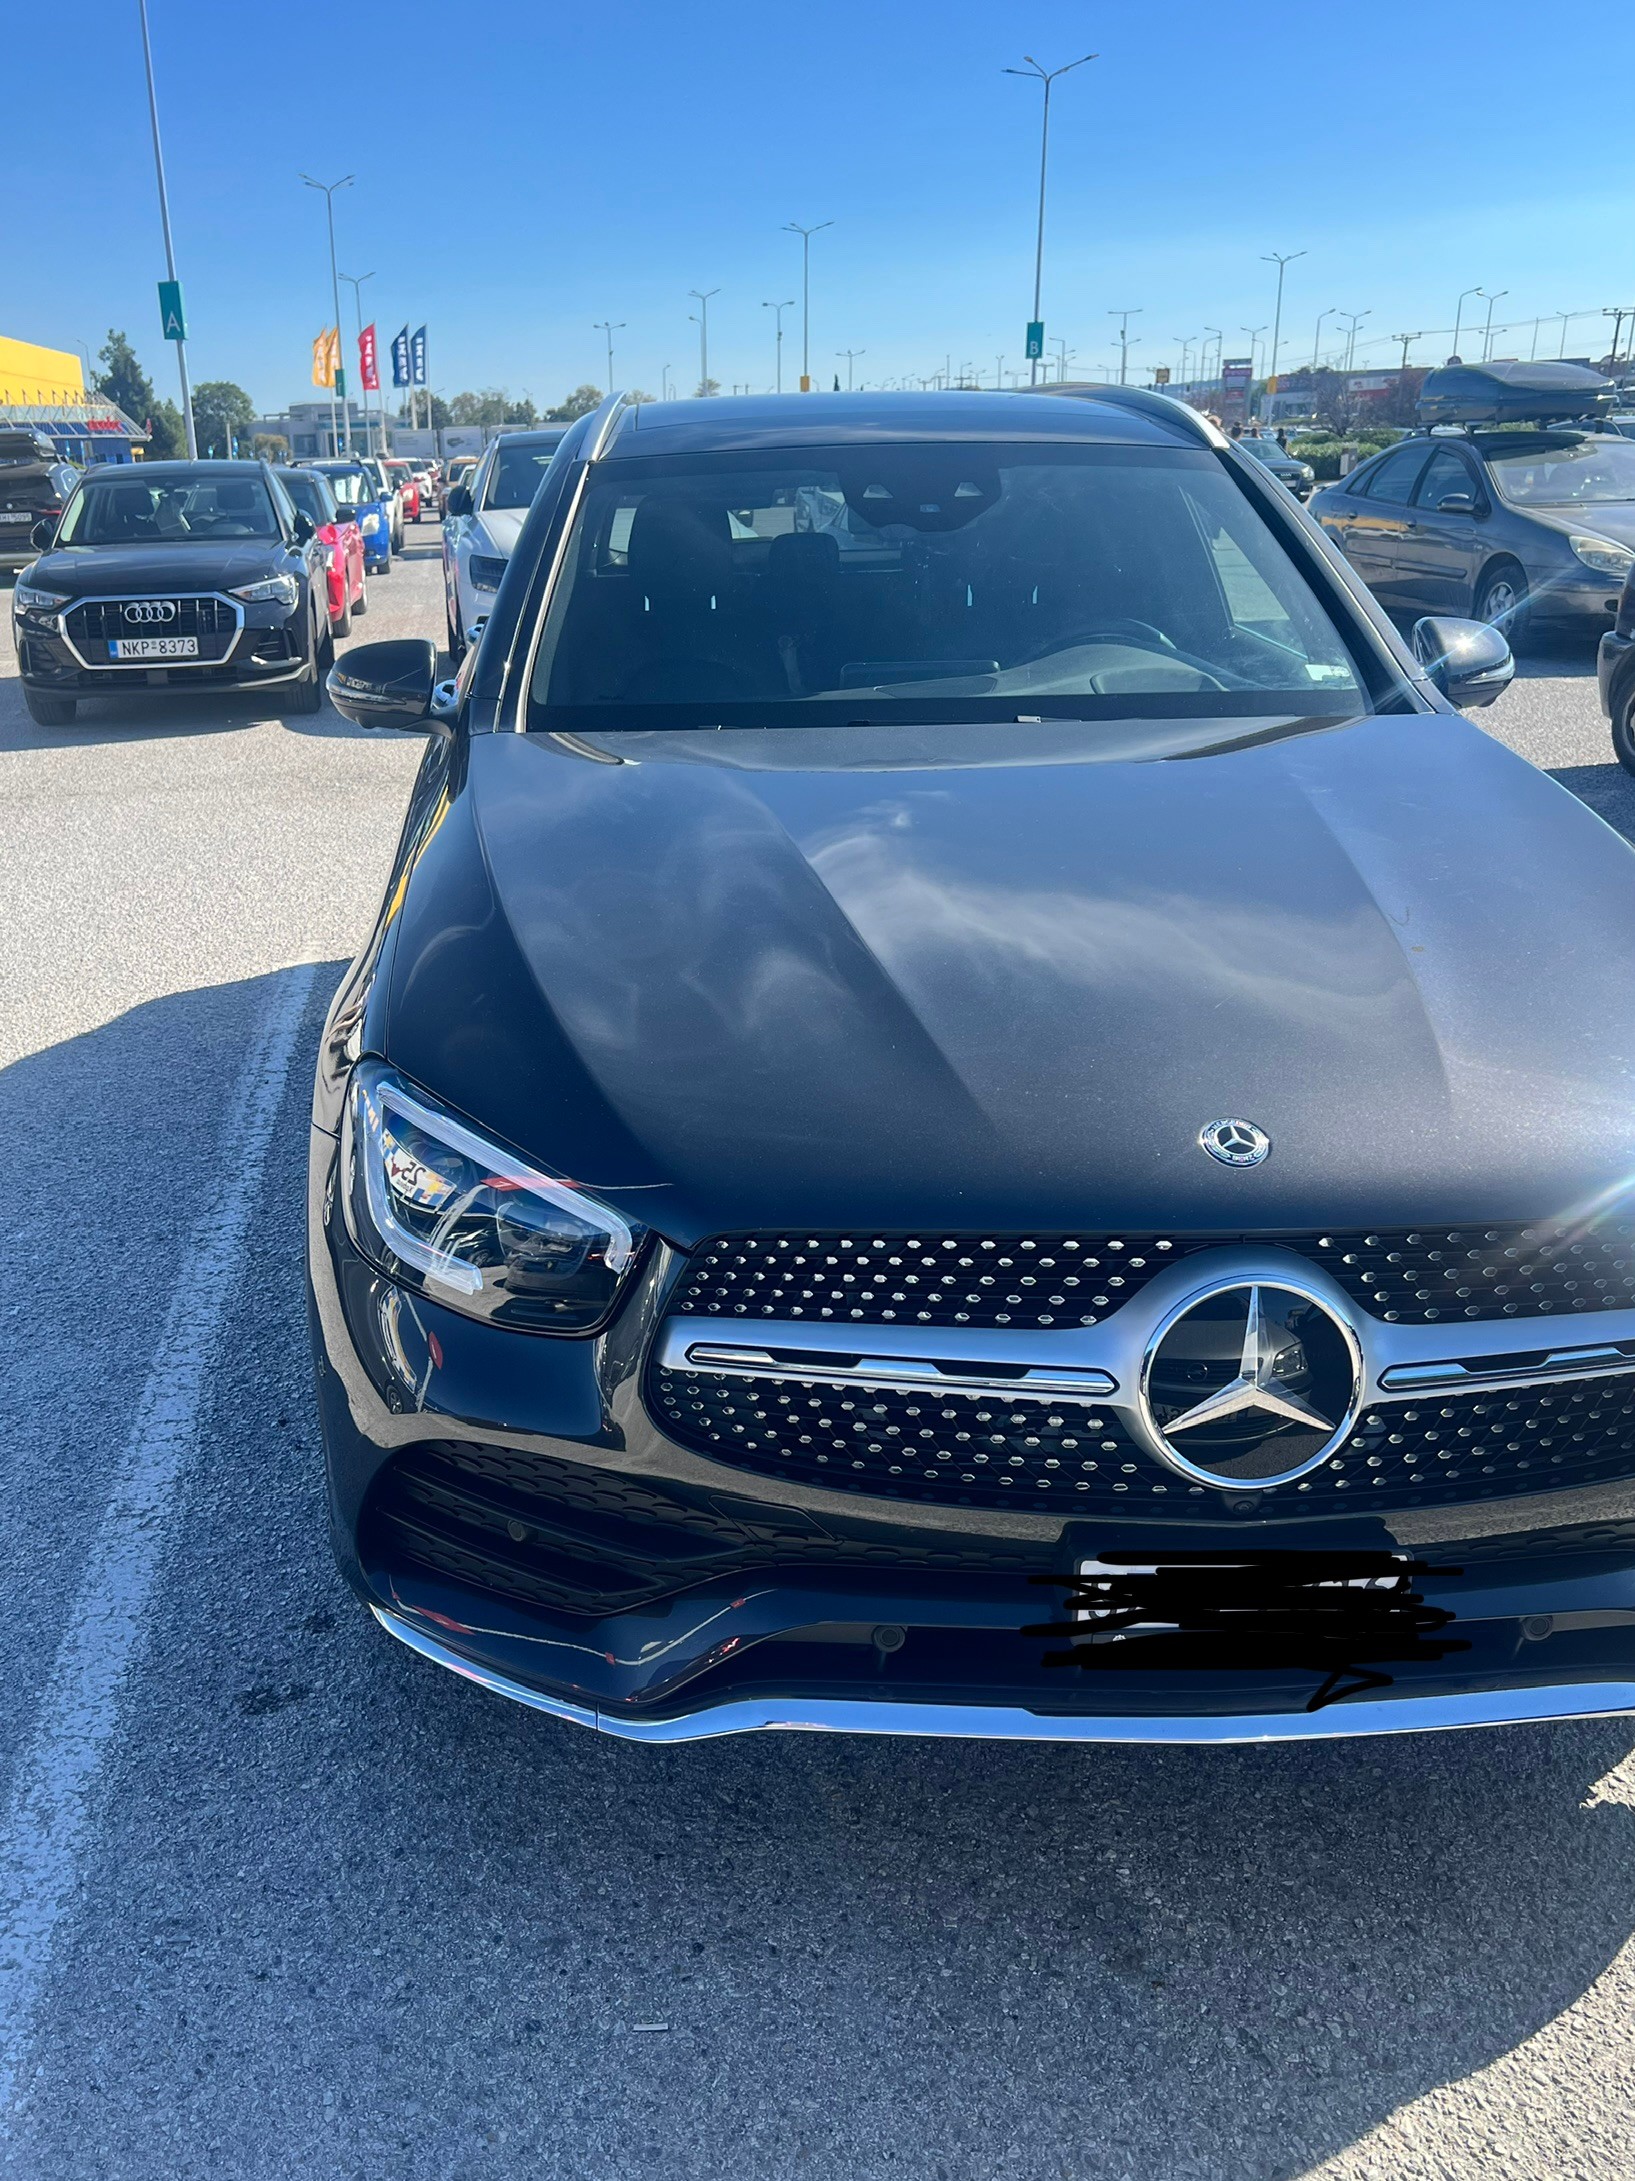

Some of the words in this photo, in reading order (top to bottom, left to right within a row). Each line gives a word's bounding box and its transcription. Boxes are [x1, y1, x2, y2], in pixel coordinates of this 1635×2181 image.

[167, 311, 181, 333] A
[398, 336, 408, 380] IKEA
[416, 337, 424, 381] IKEA
[1030, 341, 1039, 355] B
[121, 639, 196, 656] NKP-8373
